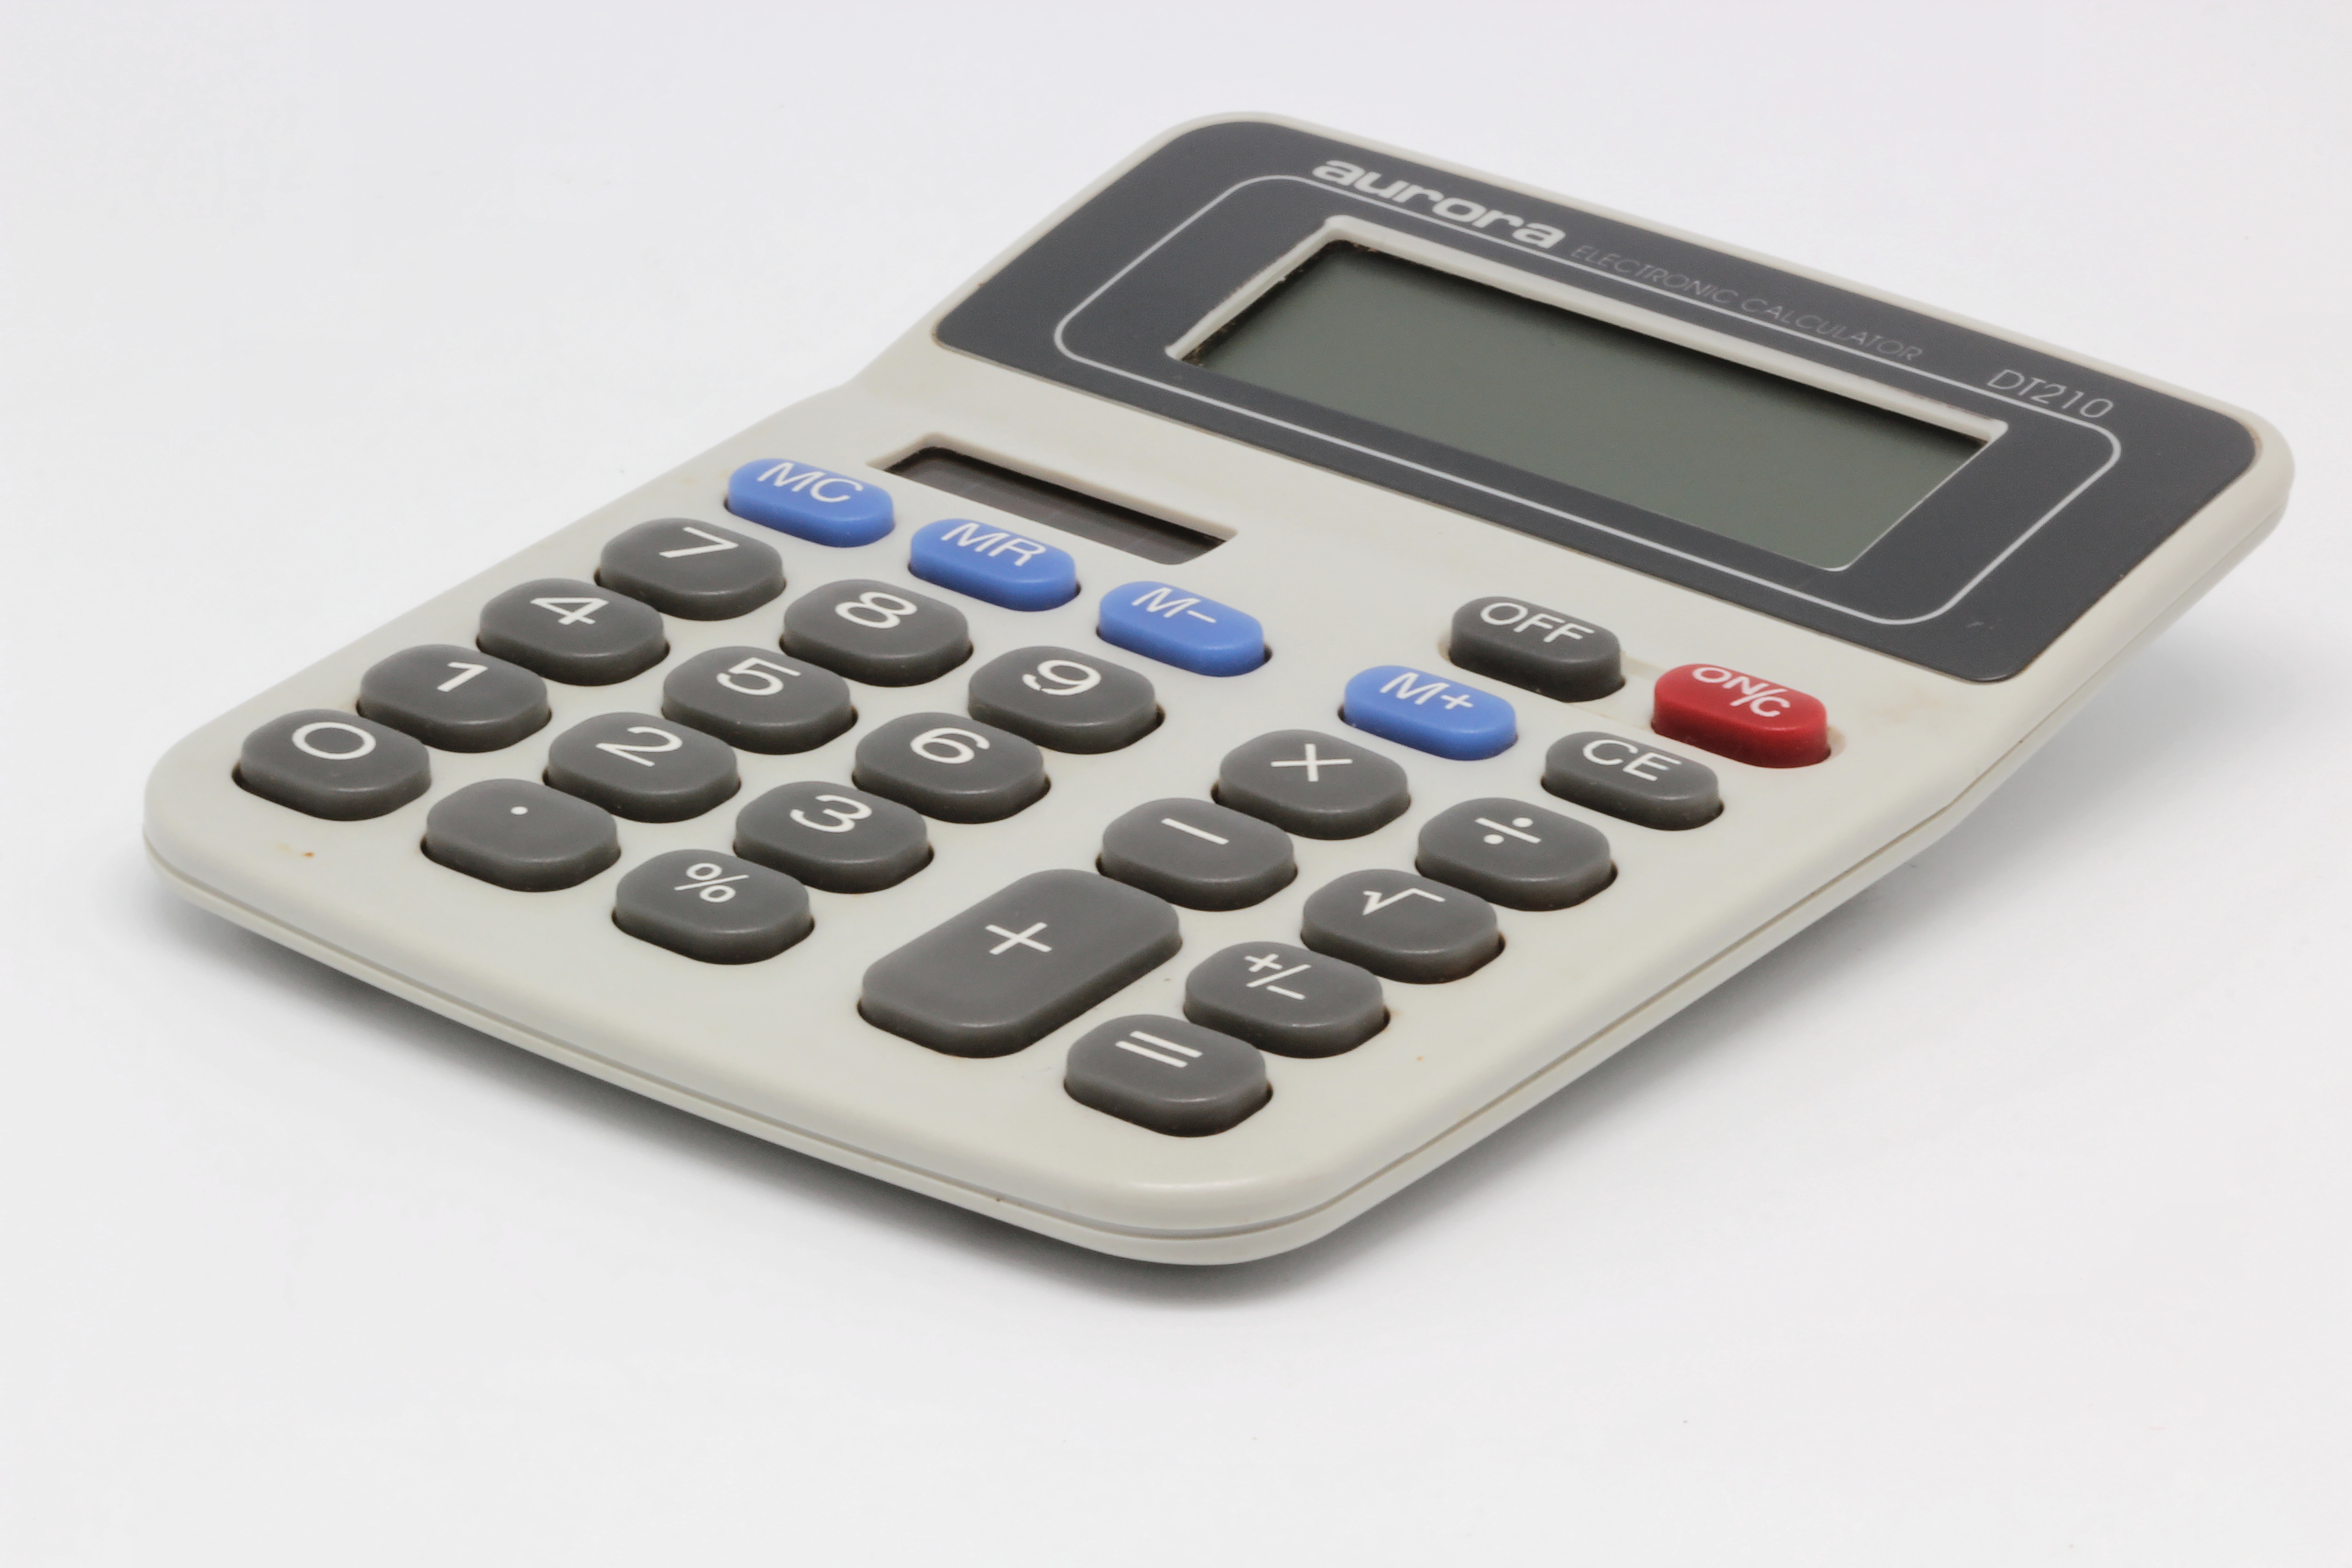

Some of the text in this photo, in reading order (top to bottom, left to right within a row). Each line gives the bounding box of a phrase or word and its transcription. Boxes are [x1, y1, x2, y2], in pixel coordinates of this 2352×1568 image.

[1312, 159, 1566, 249] aurora
[1570, 244, 1924, 362] ELECTRONIC CALCULATOR
[1987, 368, 2114, 420] DT210
[756, 461, 864, 503] MC
[658, 526, 740, 558] 7
[940, 522, 1047, 567] MR
[530, 597, 609, 625] 4
[834, 591, 919, 629] 8
[1479, 601, 1596, 644] OFF
[437, 662, 489, 693] 1
[715, 656, 803, 696] 5
[1022, 659, 1102, 696] 9
[1379, 671, 1474, 710] M+
[1692, 666, 1791, 718] ON/C
[595, 726, 683, 767] 2
[909, 727, 991, 764] 6
[1582, 738, 1683, 781] CE
[789, 794, 872, 833] 3
[674, 862, 750, 904] %
